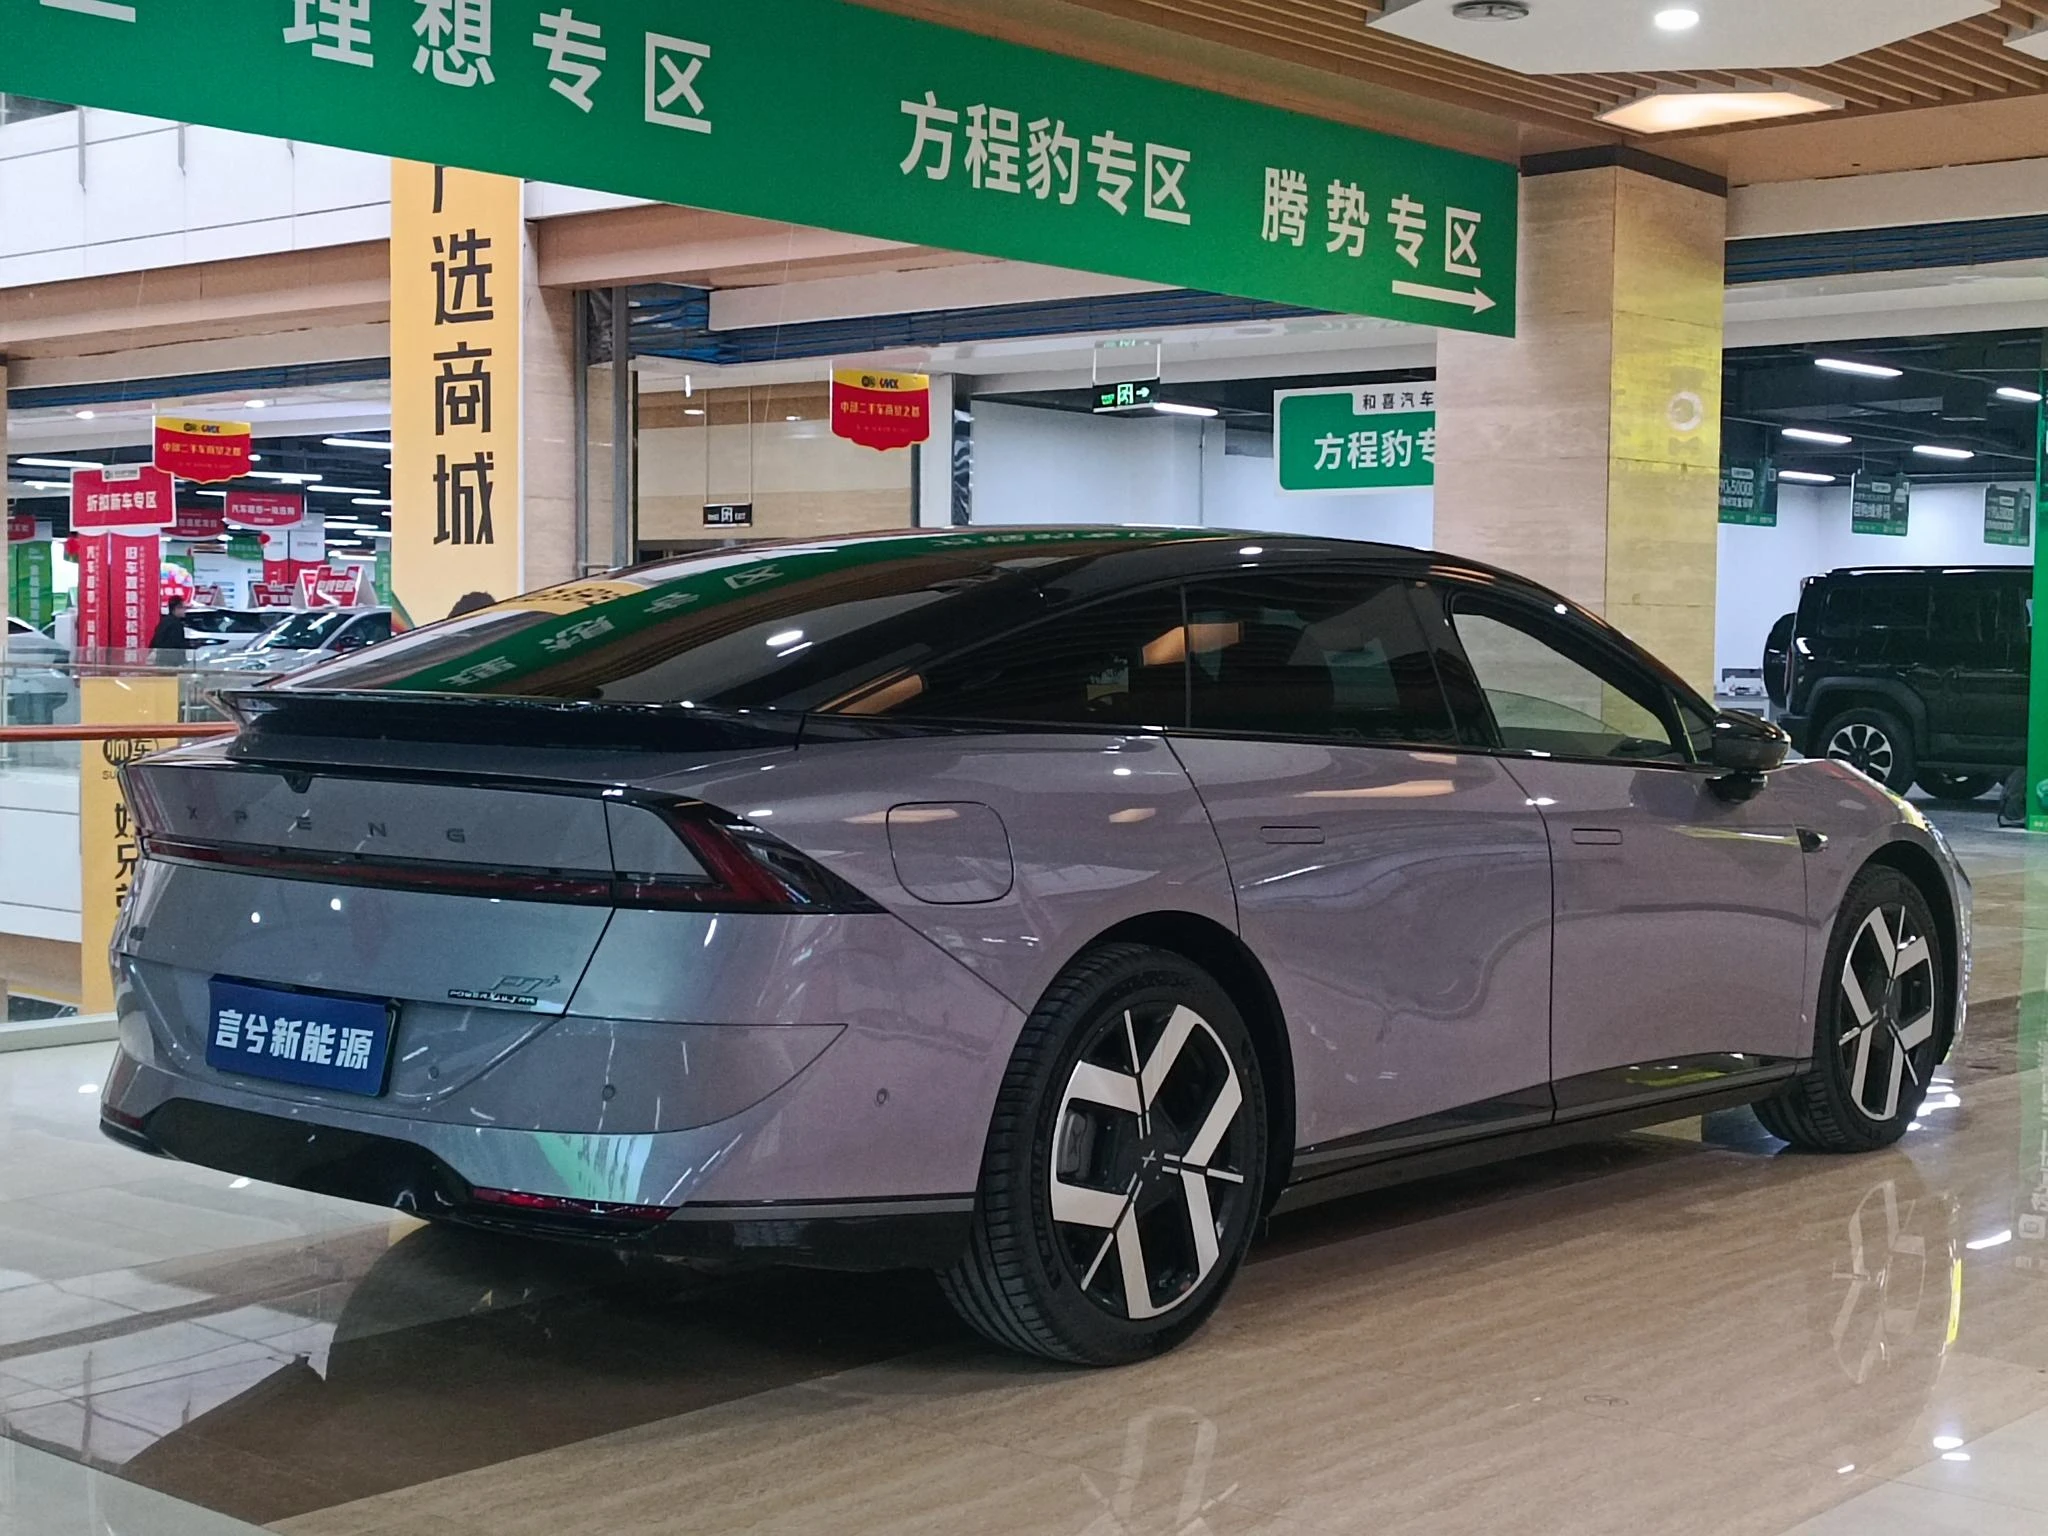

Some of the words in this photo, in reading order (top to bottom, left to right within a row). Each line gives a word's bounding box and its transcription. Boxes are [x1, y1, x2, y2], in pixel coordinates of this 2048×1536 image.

[283, 0, 712, 134] 理想专区
[900, 90, 1193, 225] 方程豹专区
[1261, 166, 1482, 278] 腾势专区
[1362, 391, 1435, 410] 和喜汽车
[188, 805, 466, 844] XPENG
[216, 1009, 374, 1071] 言兮新能源
